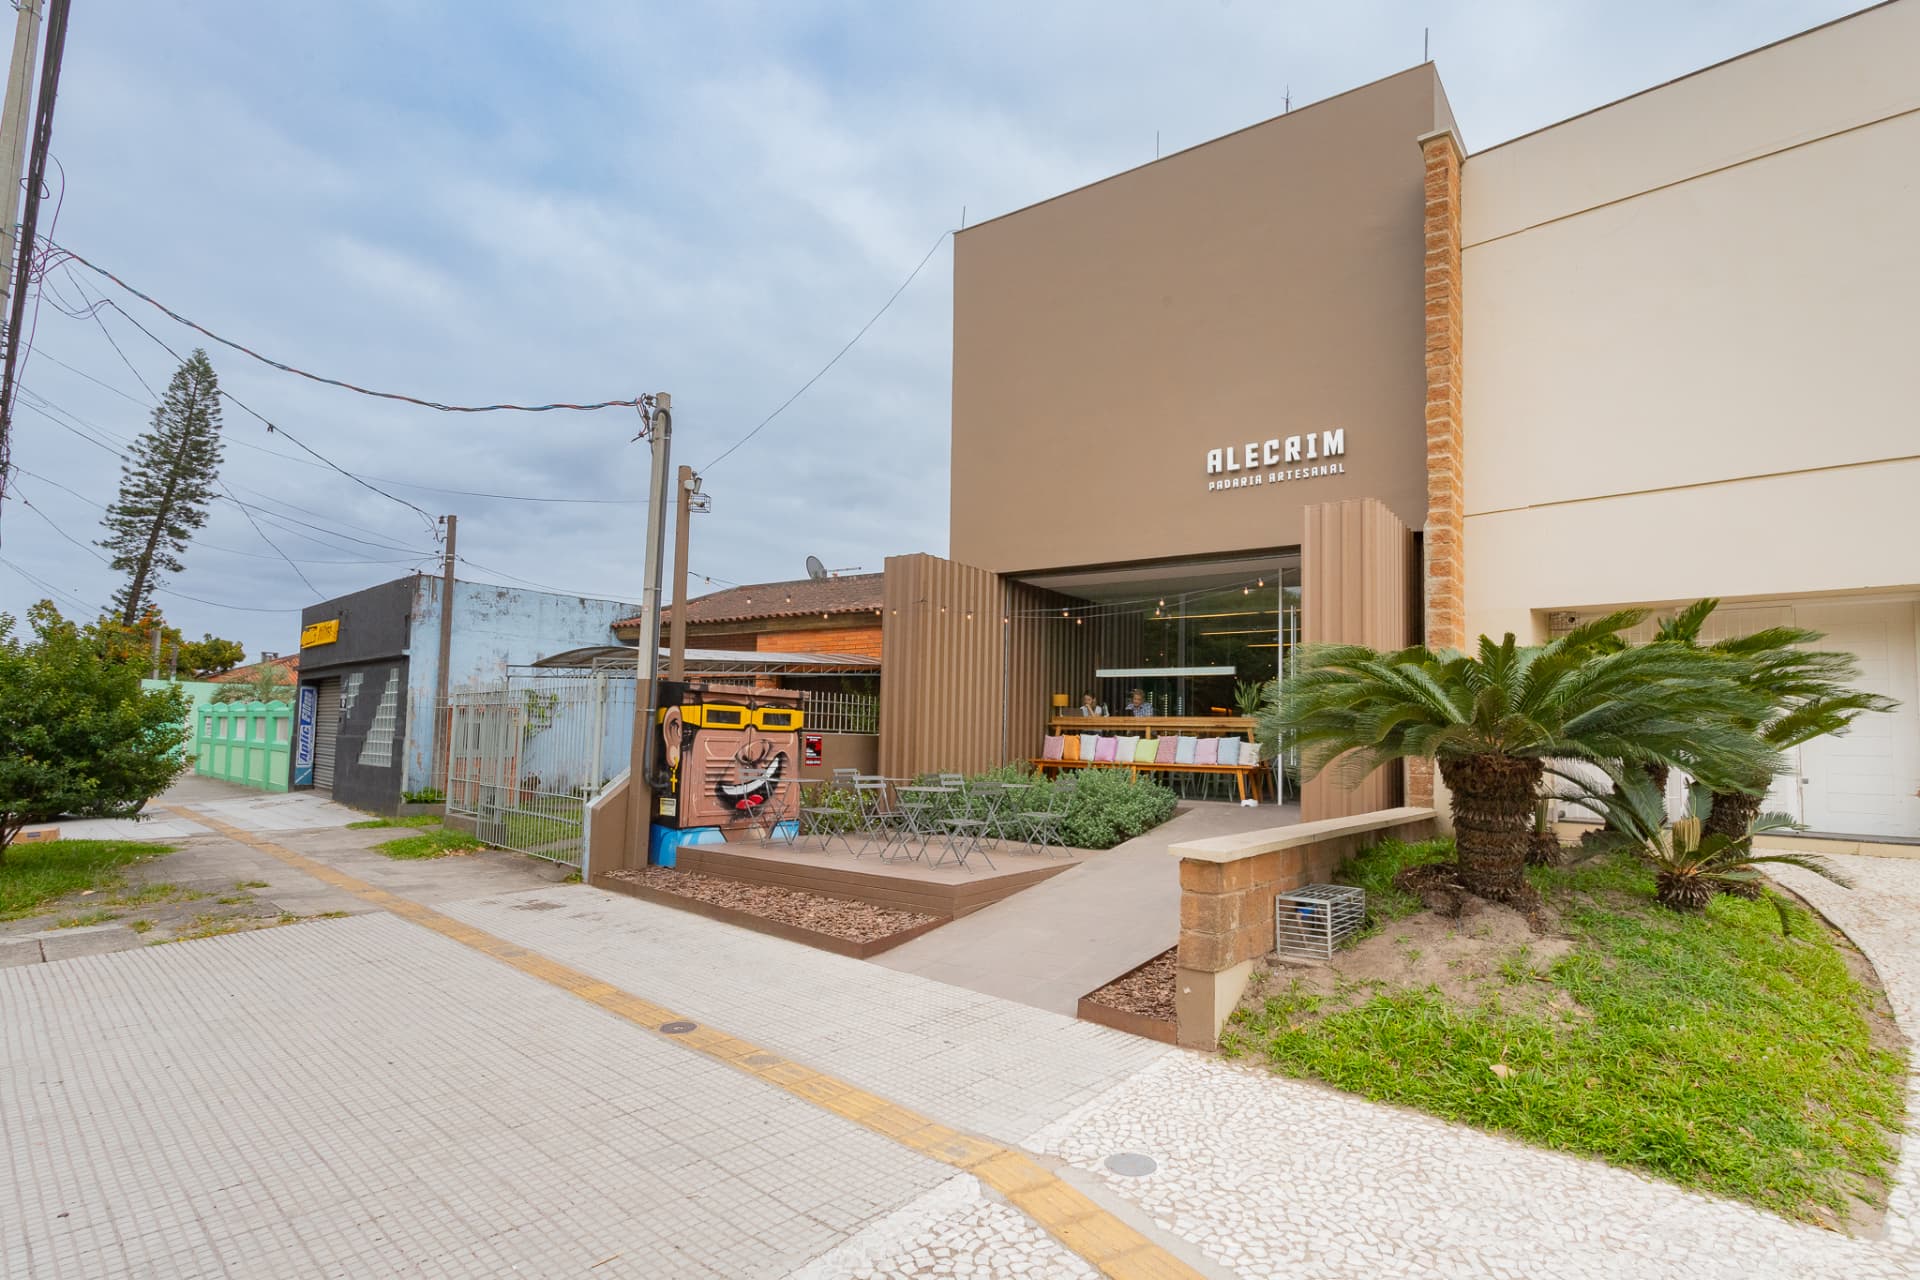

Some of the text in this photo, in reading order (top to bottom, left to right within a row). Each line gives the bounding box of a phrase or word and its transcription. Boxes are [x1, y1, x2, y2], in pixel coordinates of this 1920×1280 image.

[1207, 428, 1345, 474] ALECRIM
[1208, 463, 1345, 491] PADARIA ARTESANAL
